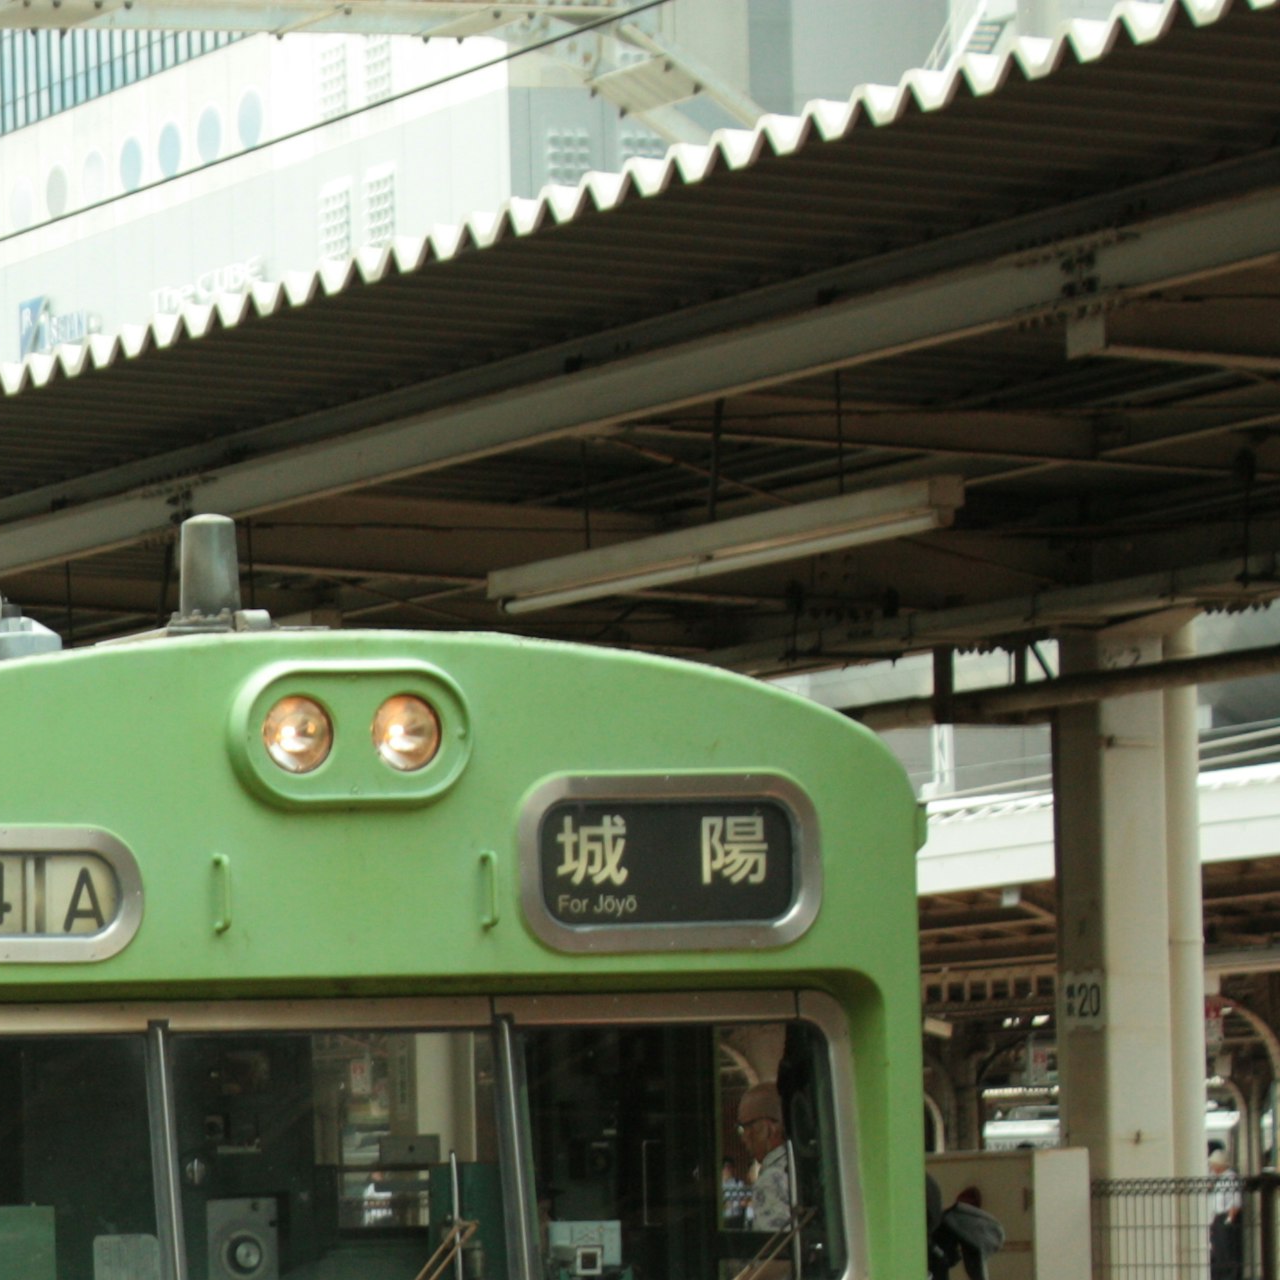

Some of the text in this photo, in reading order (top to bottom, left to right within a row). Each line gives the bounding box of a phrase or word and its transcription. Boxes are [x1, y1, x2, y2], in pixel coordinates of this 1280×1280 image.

[556, 814, 768, 885] 城陽
[558, 894, 638, 917] For Jōyō
